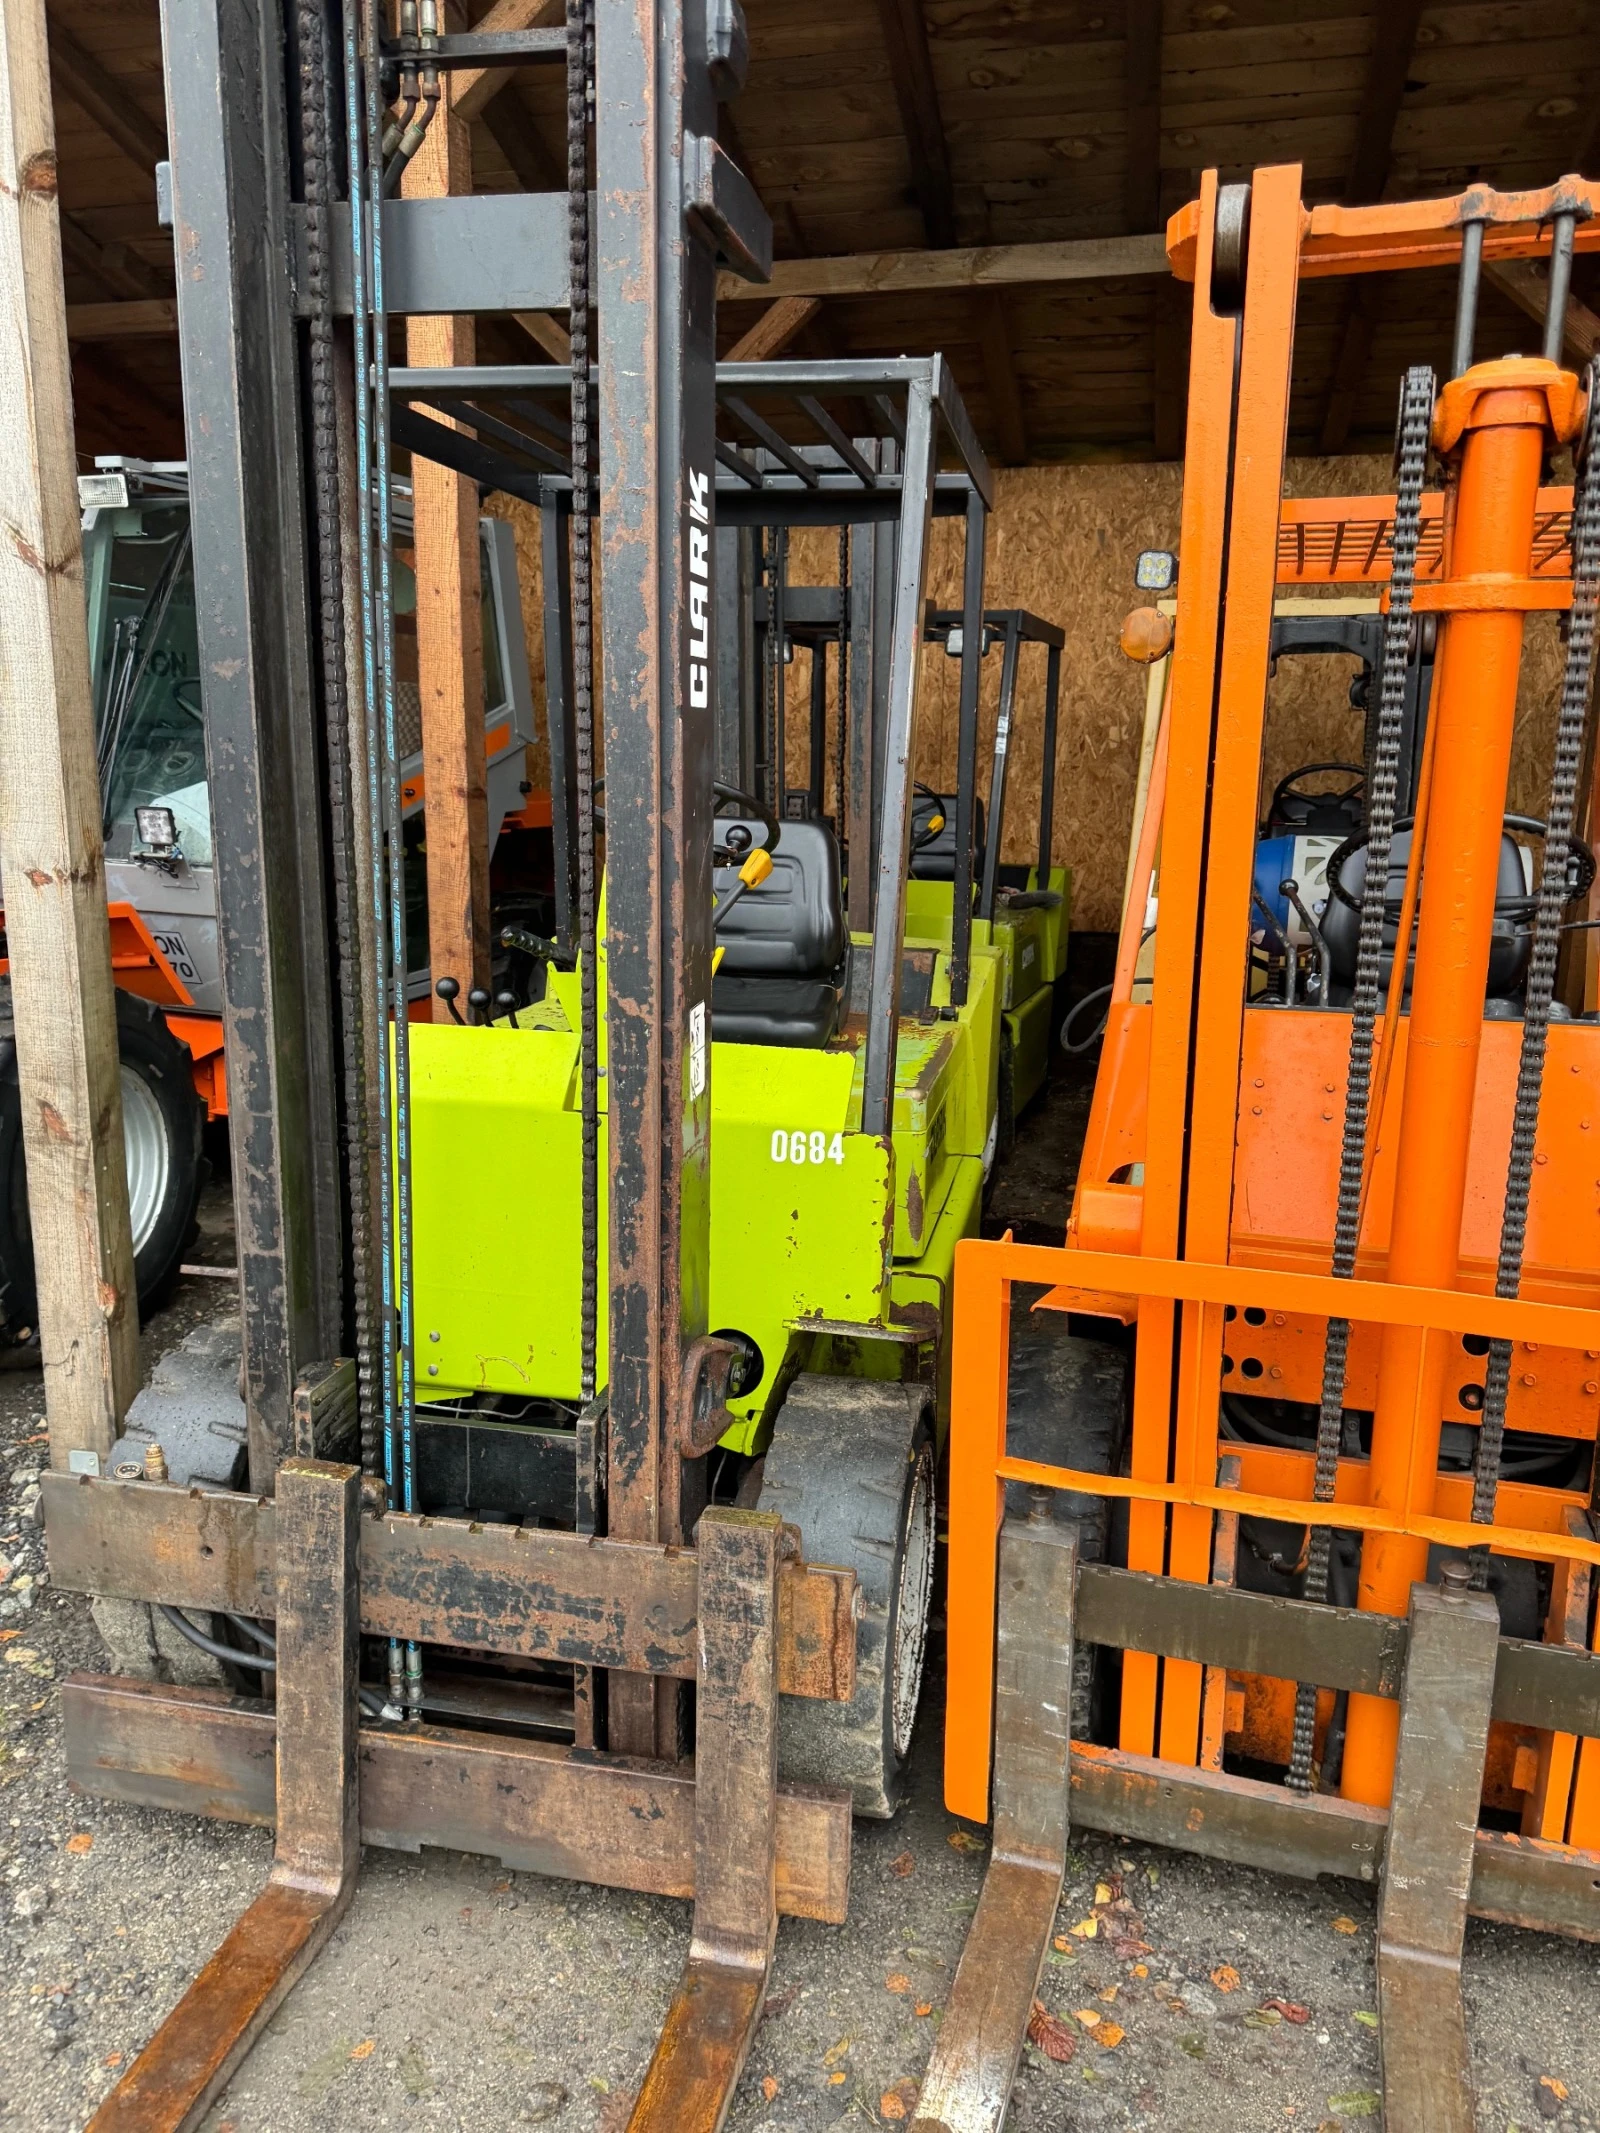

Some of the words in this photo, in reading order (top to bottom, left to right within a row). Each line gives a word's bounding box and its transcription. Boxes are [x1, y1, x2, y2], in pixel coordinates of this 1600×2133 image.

[356, 306, 362, 318] WP
[690, 466, 709, 709] CLARK
[770, 1129, 845, 1165] 0684
